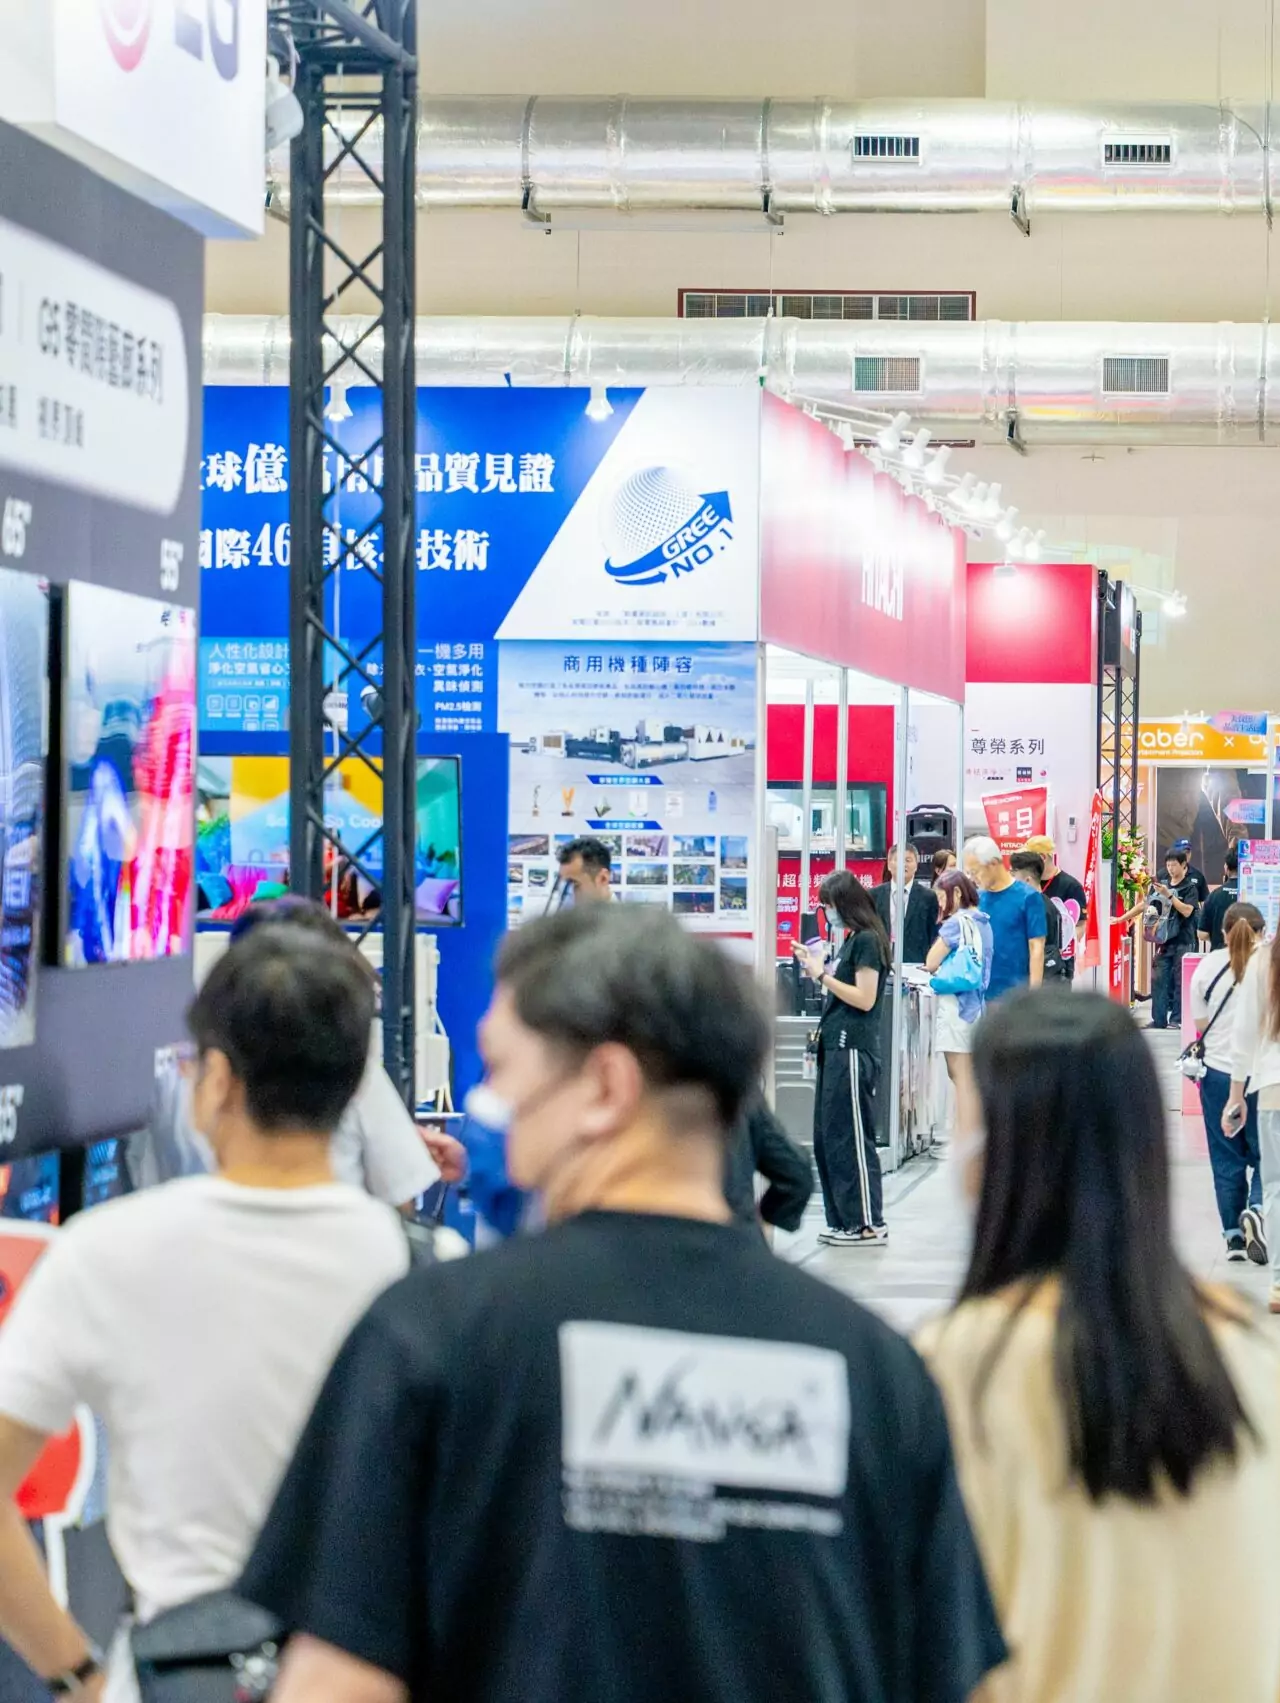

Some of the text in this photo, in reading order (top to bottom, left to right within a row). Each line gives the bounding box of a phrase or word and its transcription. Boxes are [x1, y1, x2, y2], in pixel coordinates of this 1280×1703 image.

[662, 504, 719, 560] GREE
[418, 643, 484, 660] 一機多用
[563, 655, 693, 674] 商用機種陣容
[971, 738, 1044, 755] 尊榮系列
